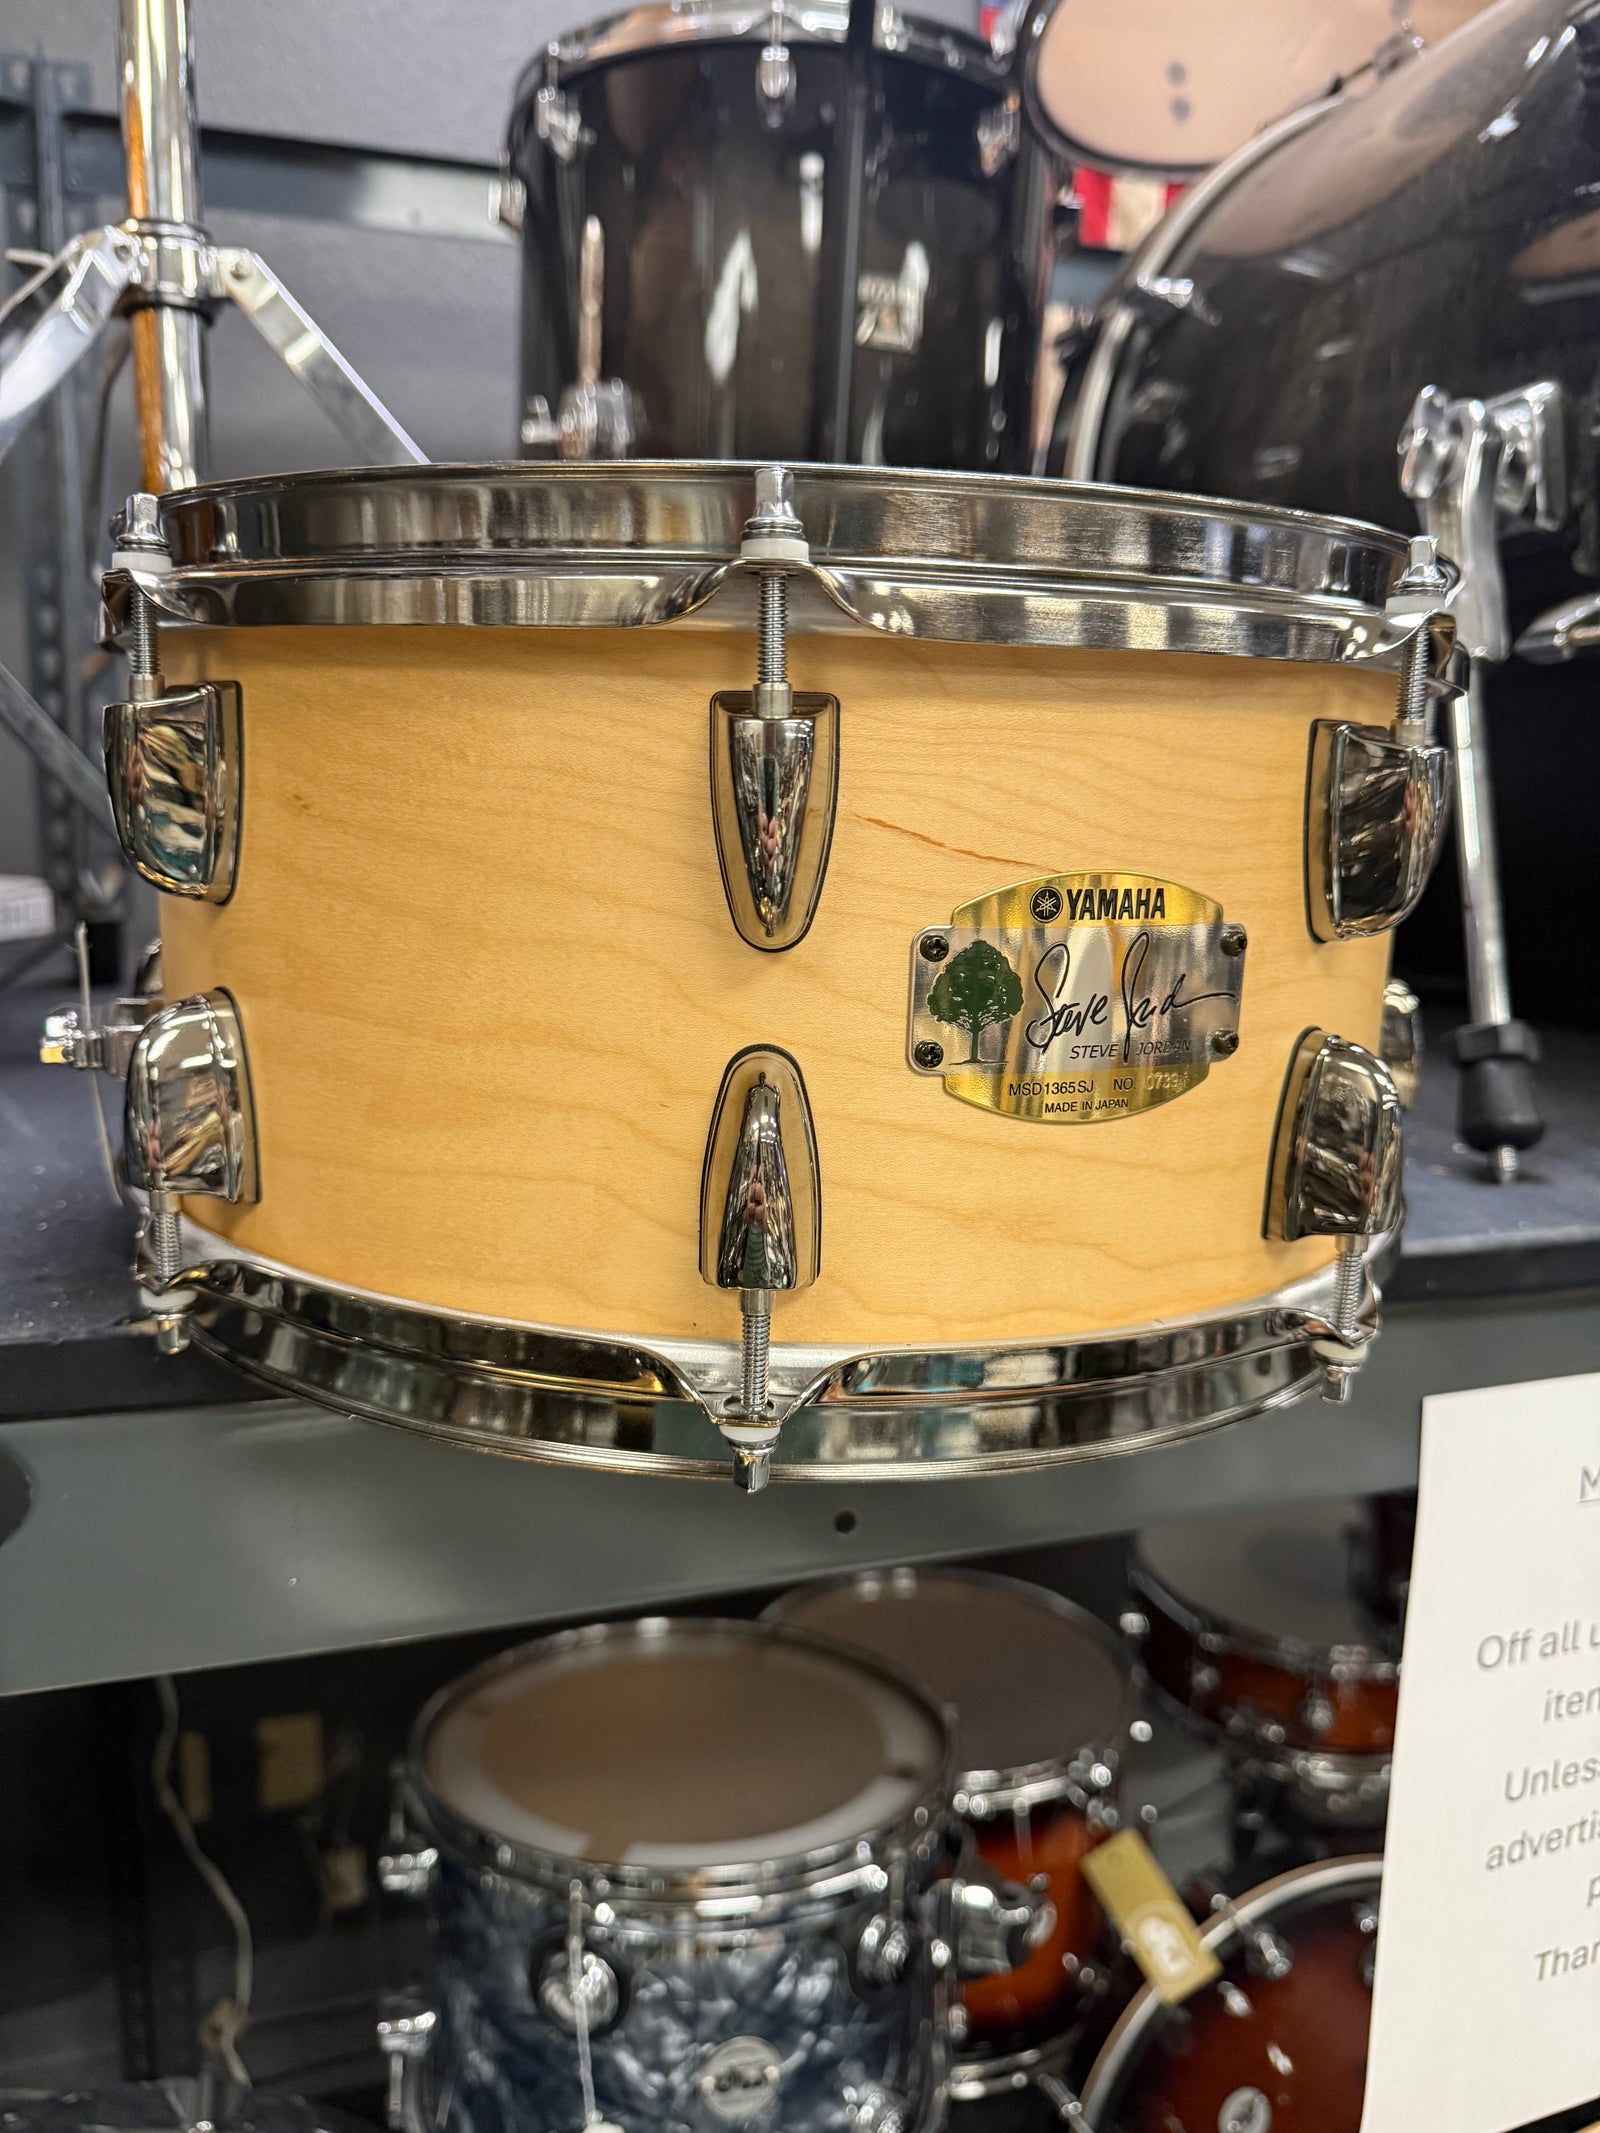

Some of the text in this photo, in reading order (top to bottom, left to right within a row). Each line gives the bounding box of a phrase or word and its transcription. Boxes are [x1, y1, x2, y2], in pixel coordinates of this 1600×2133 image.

[1067, 888, 1165, 921] YAMAHA
[1070, 1040, 1191, 1059] STEVE JORDAN
[1009, 1080, 1094, 1096] MSD1365SJ
[1045, 1099, 1129, 1113] MADE IN JAPAN
[1478, 1627, 1533, 1669] Off
[1540, 1619, 1579, 1658] all
[1505, 1758, 1600, 1801] Unles
[1486, 1810, 1600, 1870] adverti
